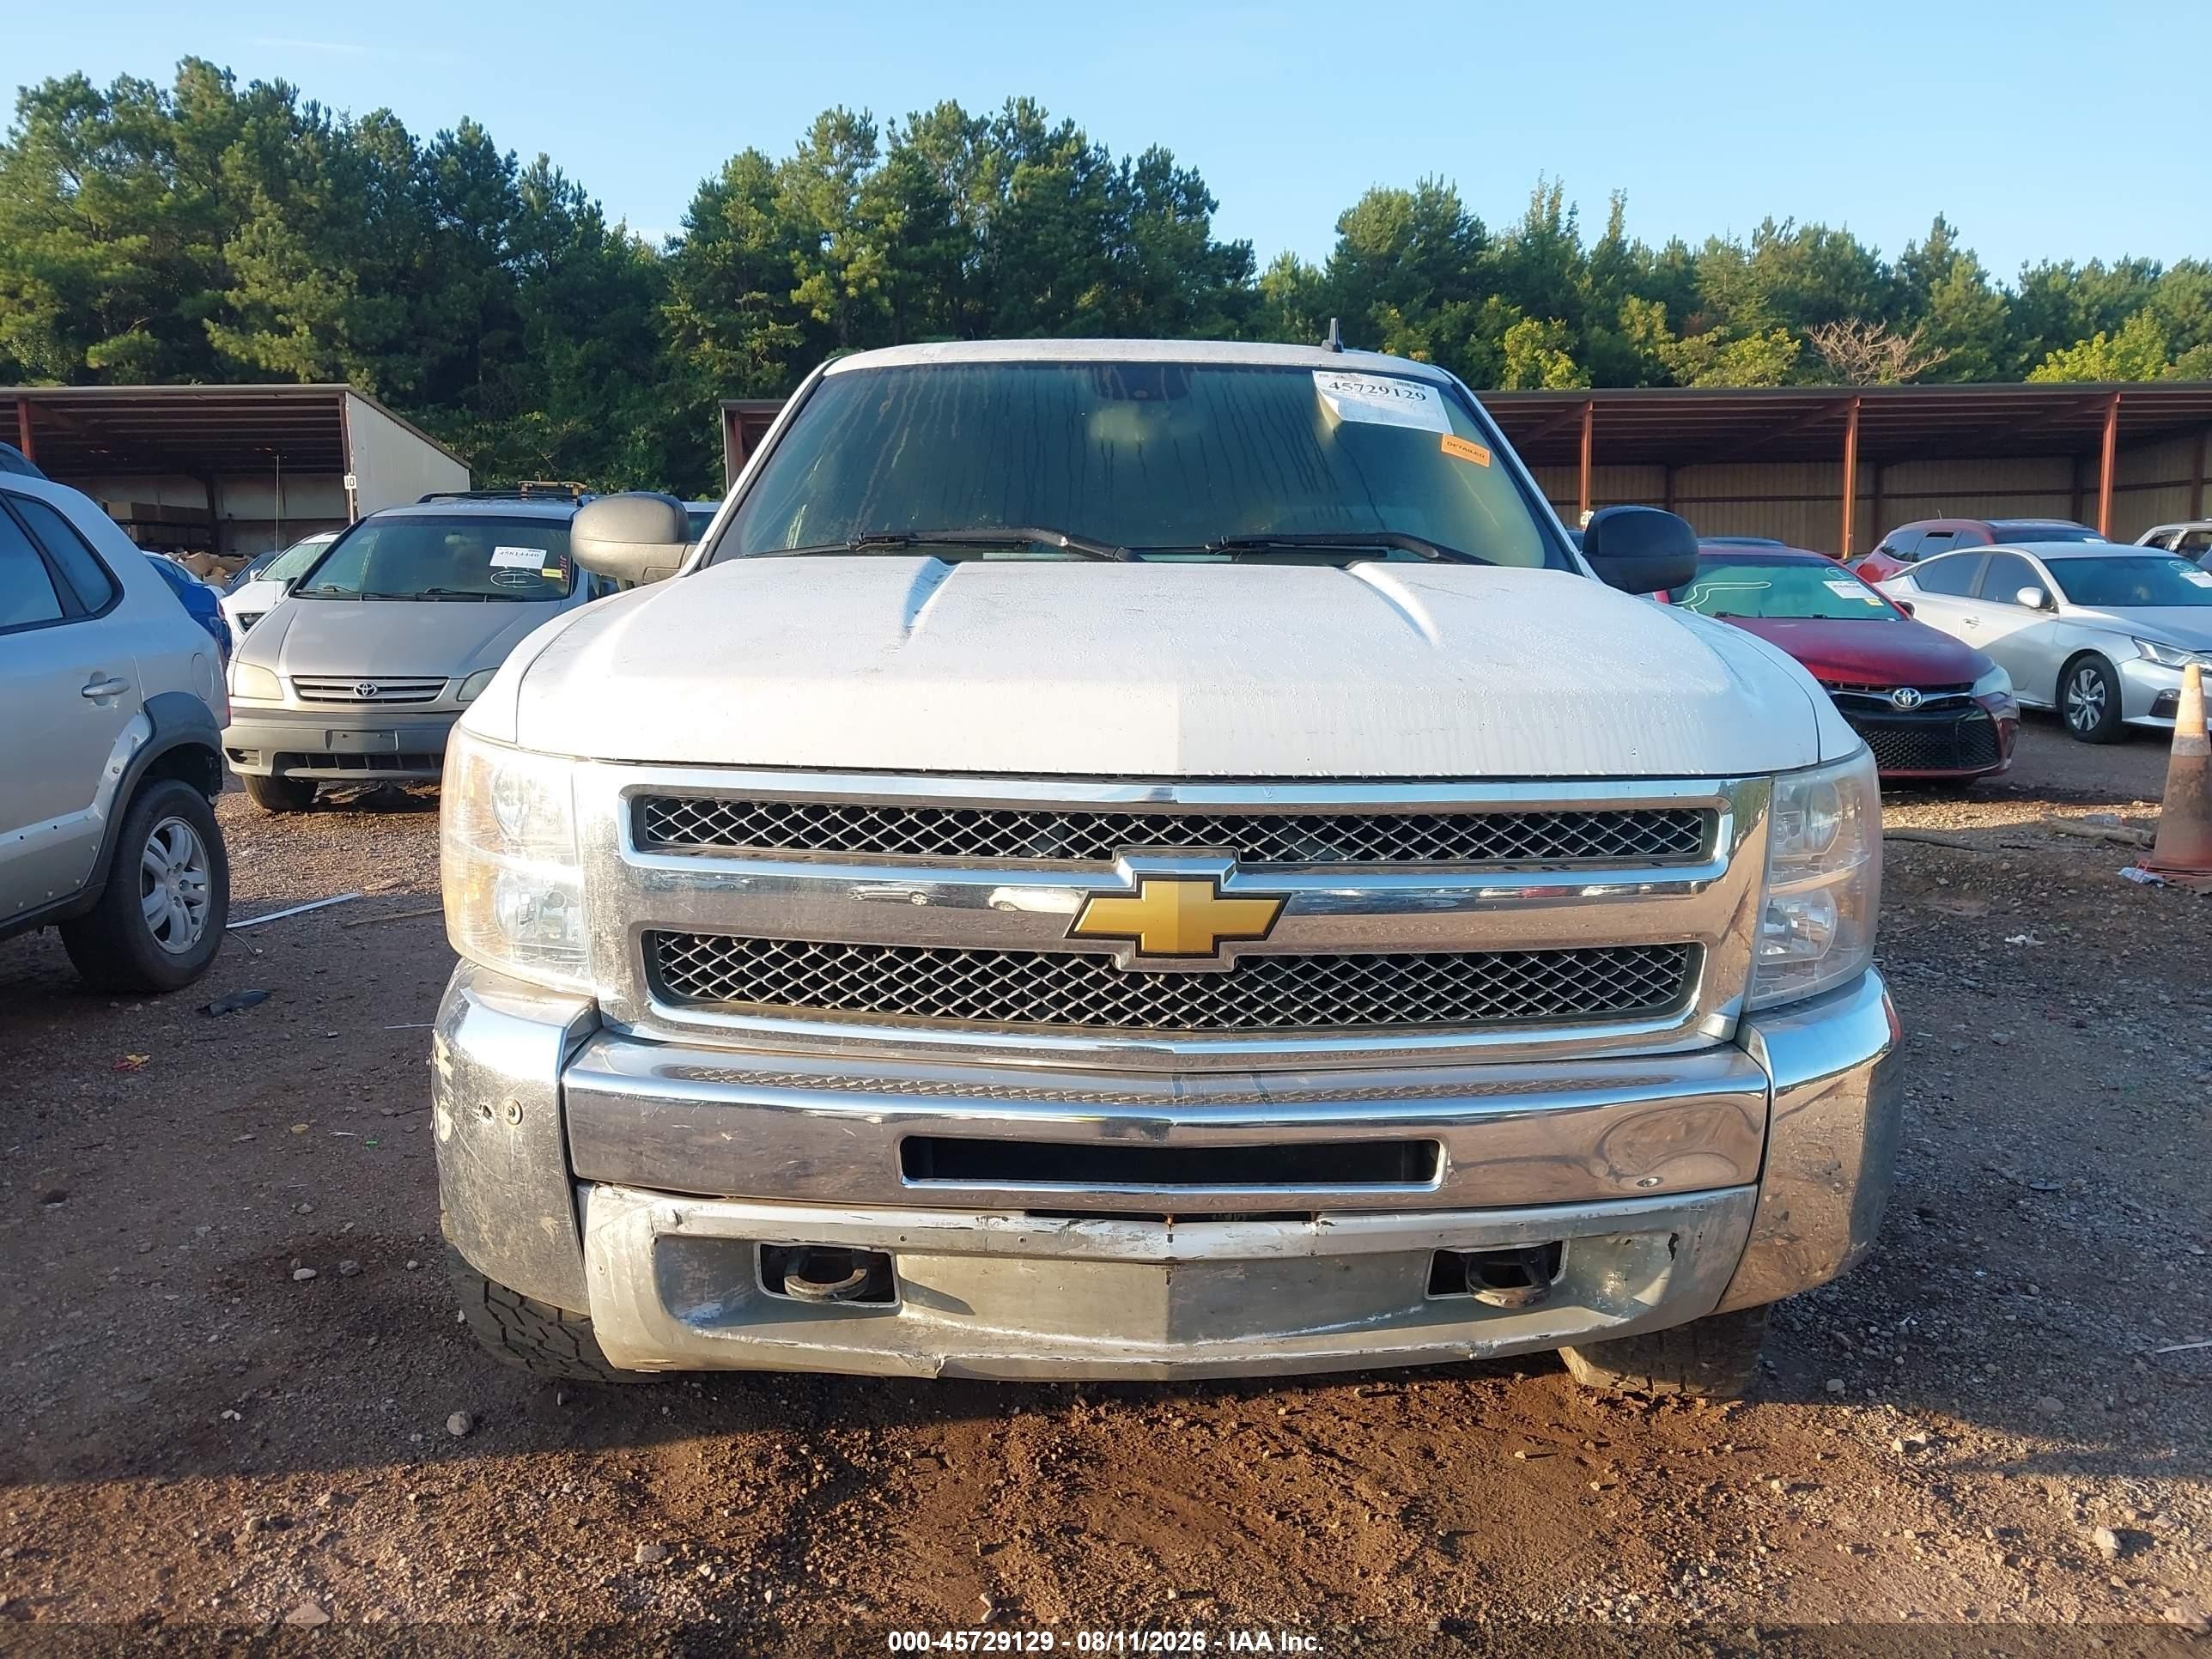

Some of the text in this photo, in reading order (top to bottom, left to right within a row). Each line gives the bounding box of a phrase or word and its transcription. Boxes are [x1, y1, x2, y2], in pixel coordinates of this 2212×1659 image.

[1328, 380, 1427, 402] 45729129
[1446, 440, 1486, 459] DETAILED
[346, 477, 355, 487] 10
